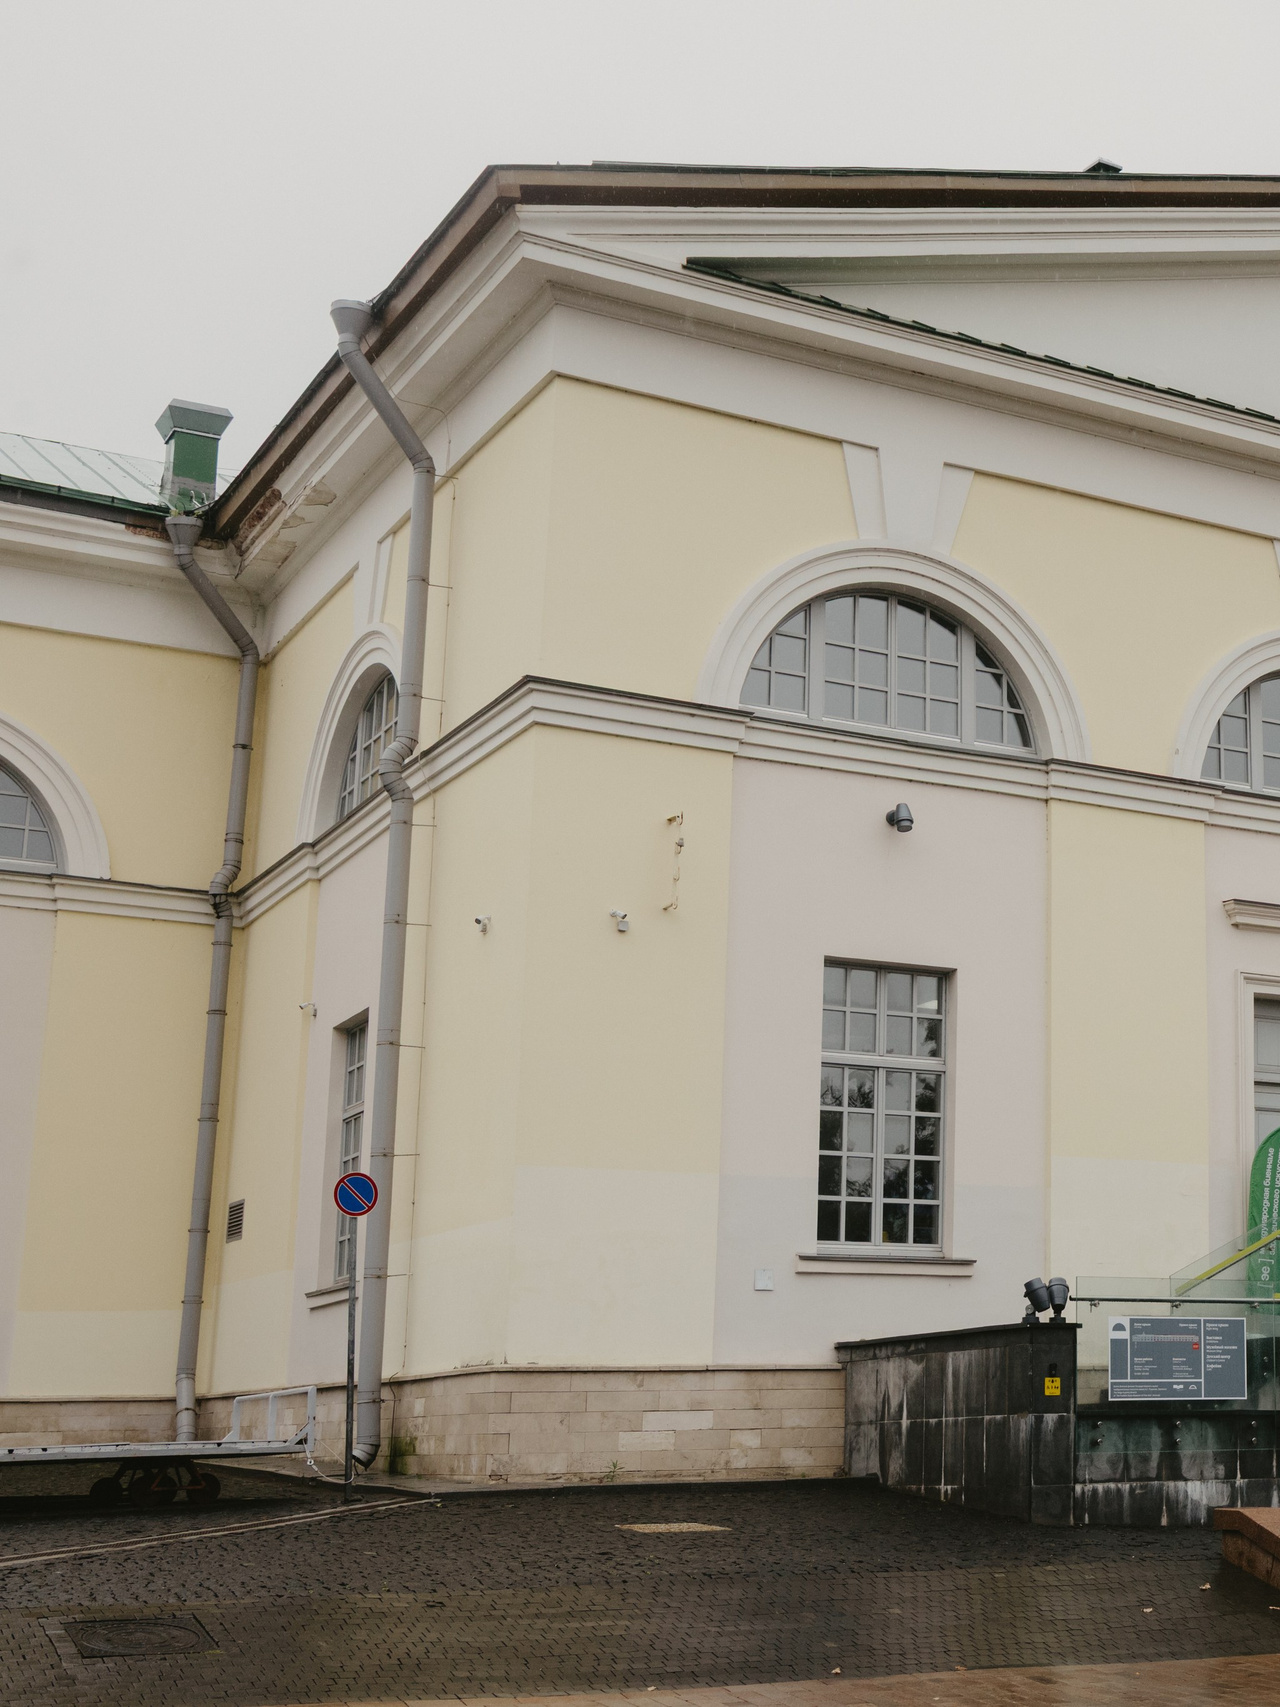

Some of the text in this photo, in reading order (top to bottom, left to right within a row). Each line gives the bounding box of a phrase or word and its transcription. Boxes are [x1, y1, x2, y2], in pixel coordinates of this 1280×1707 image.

[1260, 1147, 1275, 1255] мдународная биеннале
[1270, 1189, 1280, 1256] экогического
